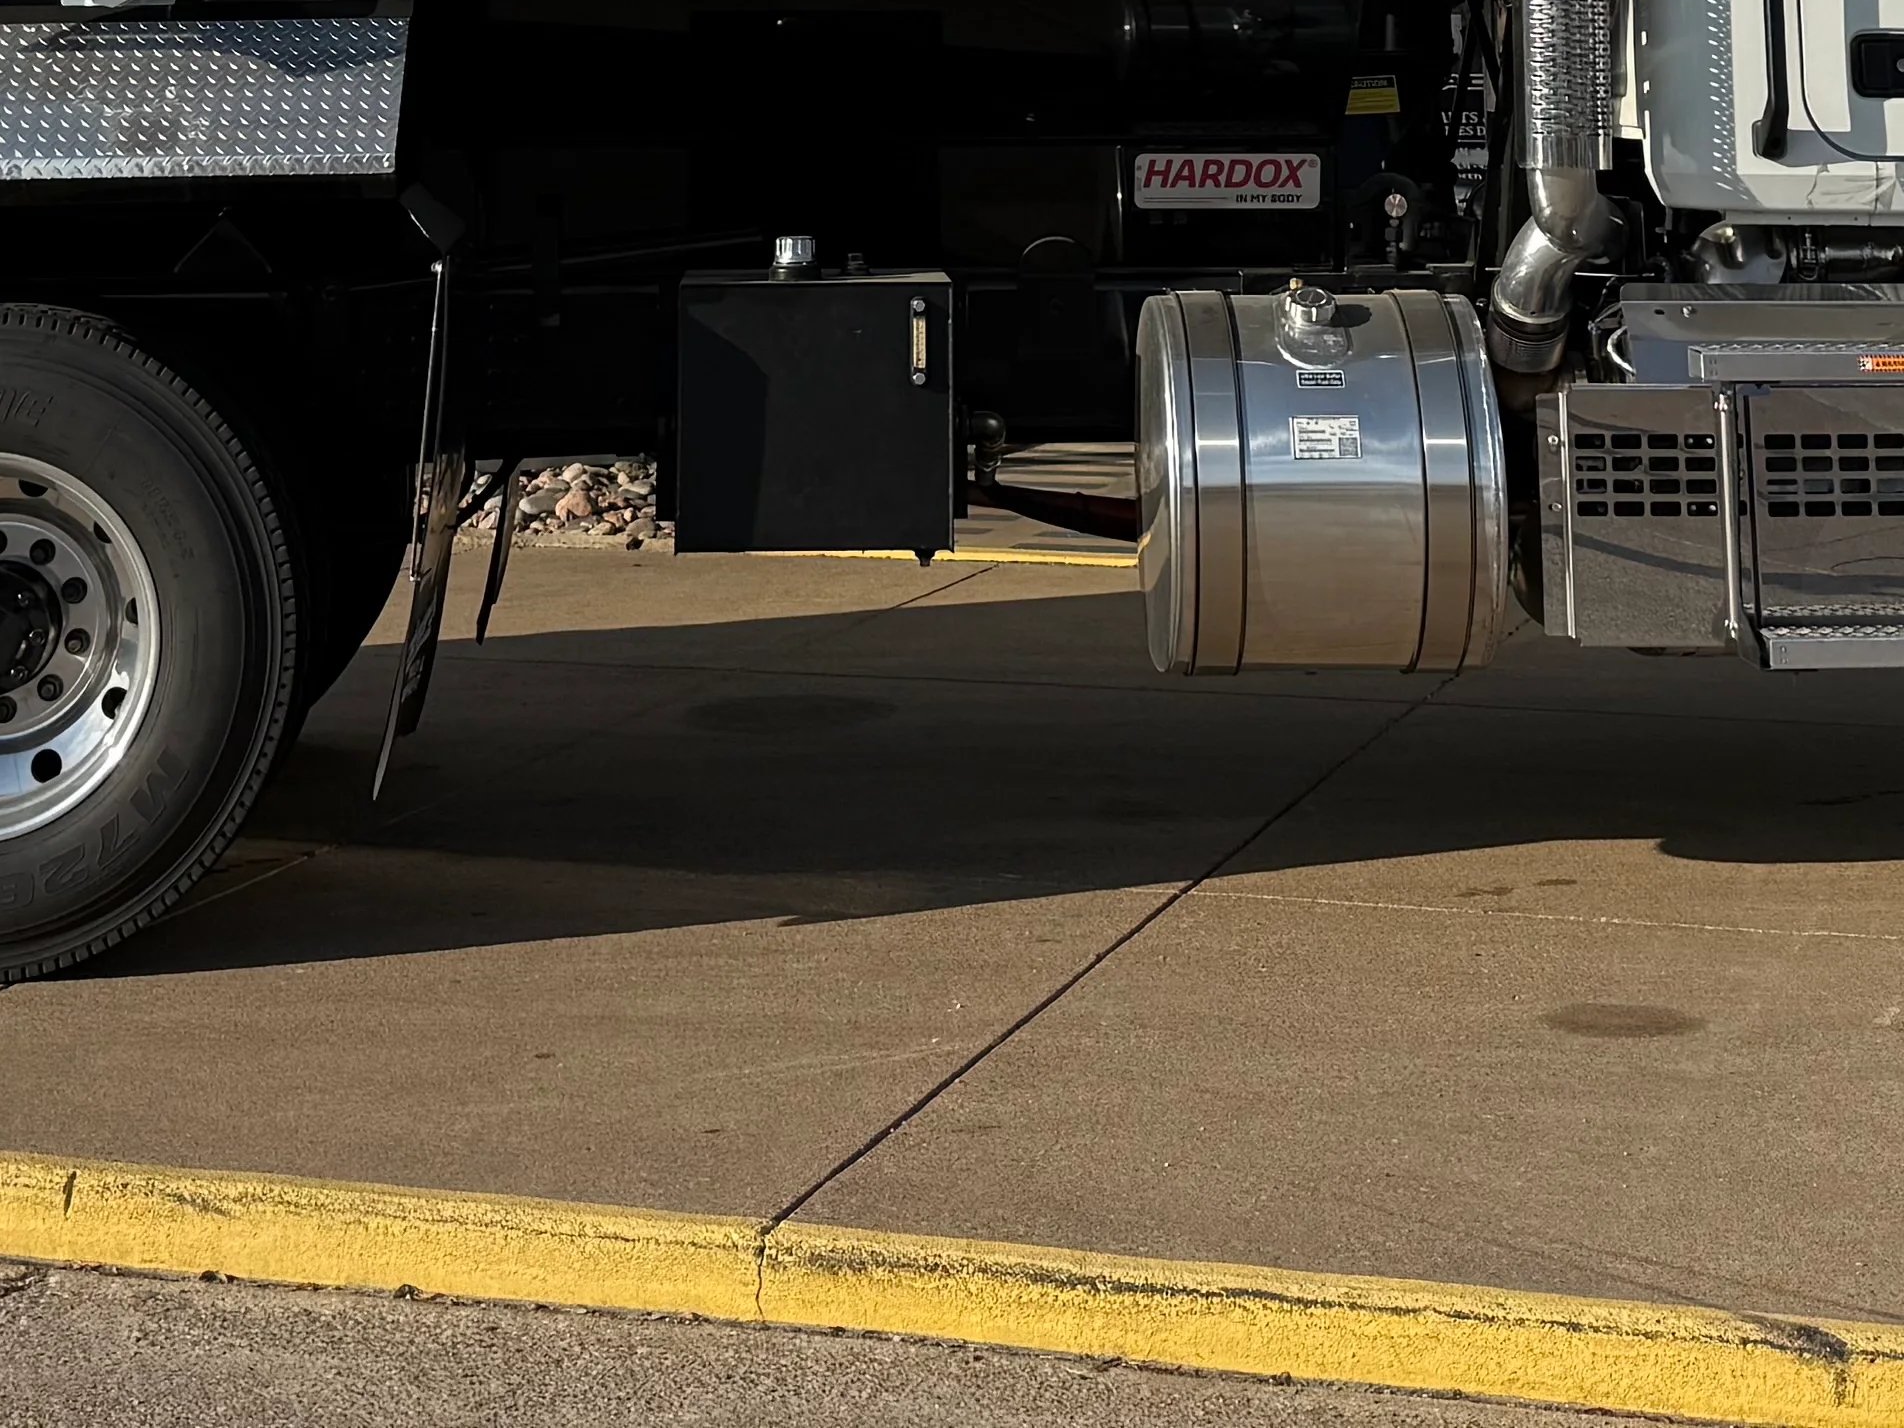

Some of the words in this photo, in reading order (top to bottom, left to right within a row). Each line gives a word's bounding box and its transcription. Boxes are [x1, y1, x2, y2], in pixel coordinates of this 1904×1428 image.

[1143, 158, 1308, 189] HARDOX
[1235, 194, 1248, 204] IN
[1250, 194, 1267, 204] MY
